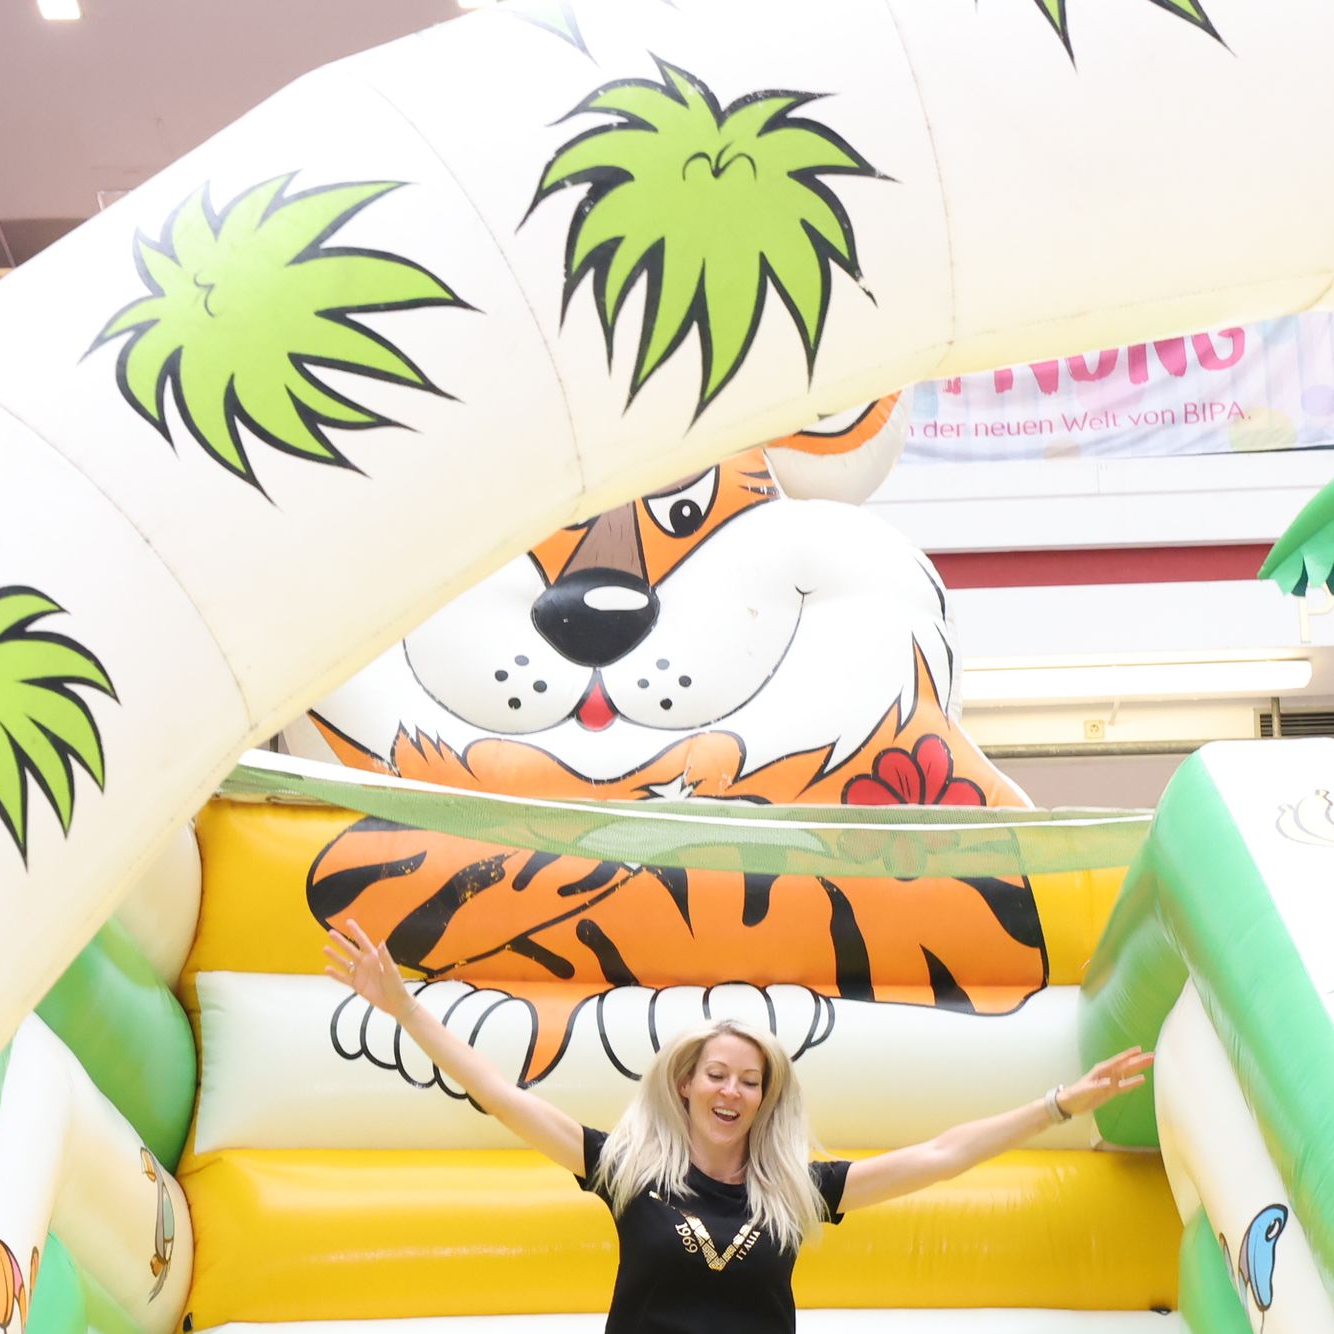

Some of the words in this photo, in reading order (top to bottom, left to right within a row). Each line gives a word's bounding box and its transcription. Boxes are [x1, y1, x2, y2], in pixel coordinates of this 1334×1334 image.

[923, 421, 964, 438] der
[975, 417, 1053, 438] neuen
[1061, 410, 1120, 433] Welt
[1128, 408, 1175, 426] von
[1183, 400, 1252, 425] BIPA.
[674, 1221, 699, 1254] 1969
[735, 1230, 762, 1261] ITALIA
